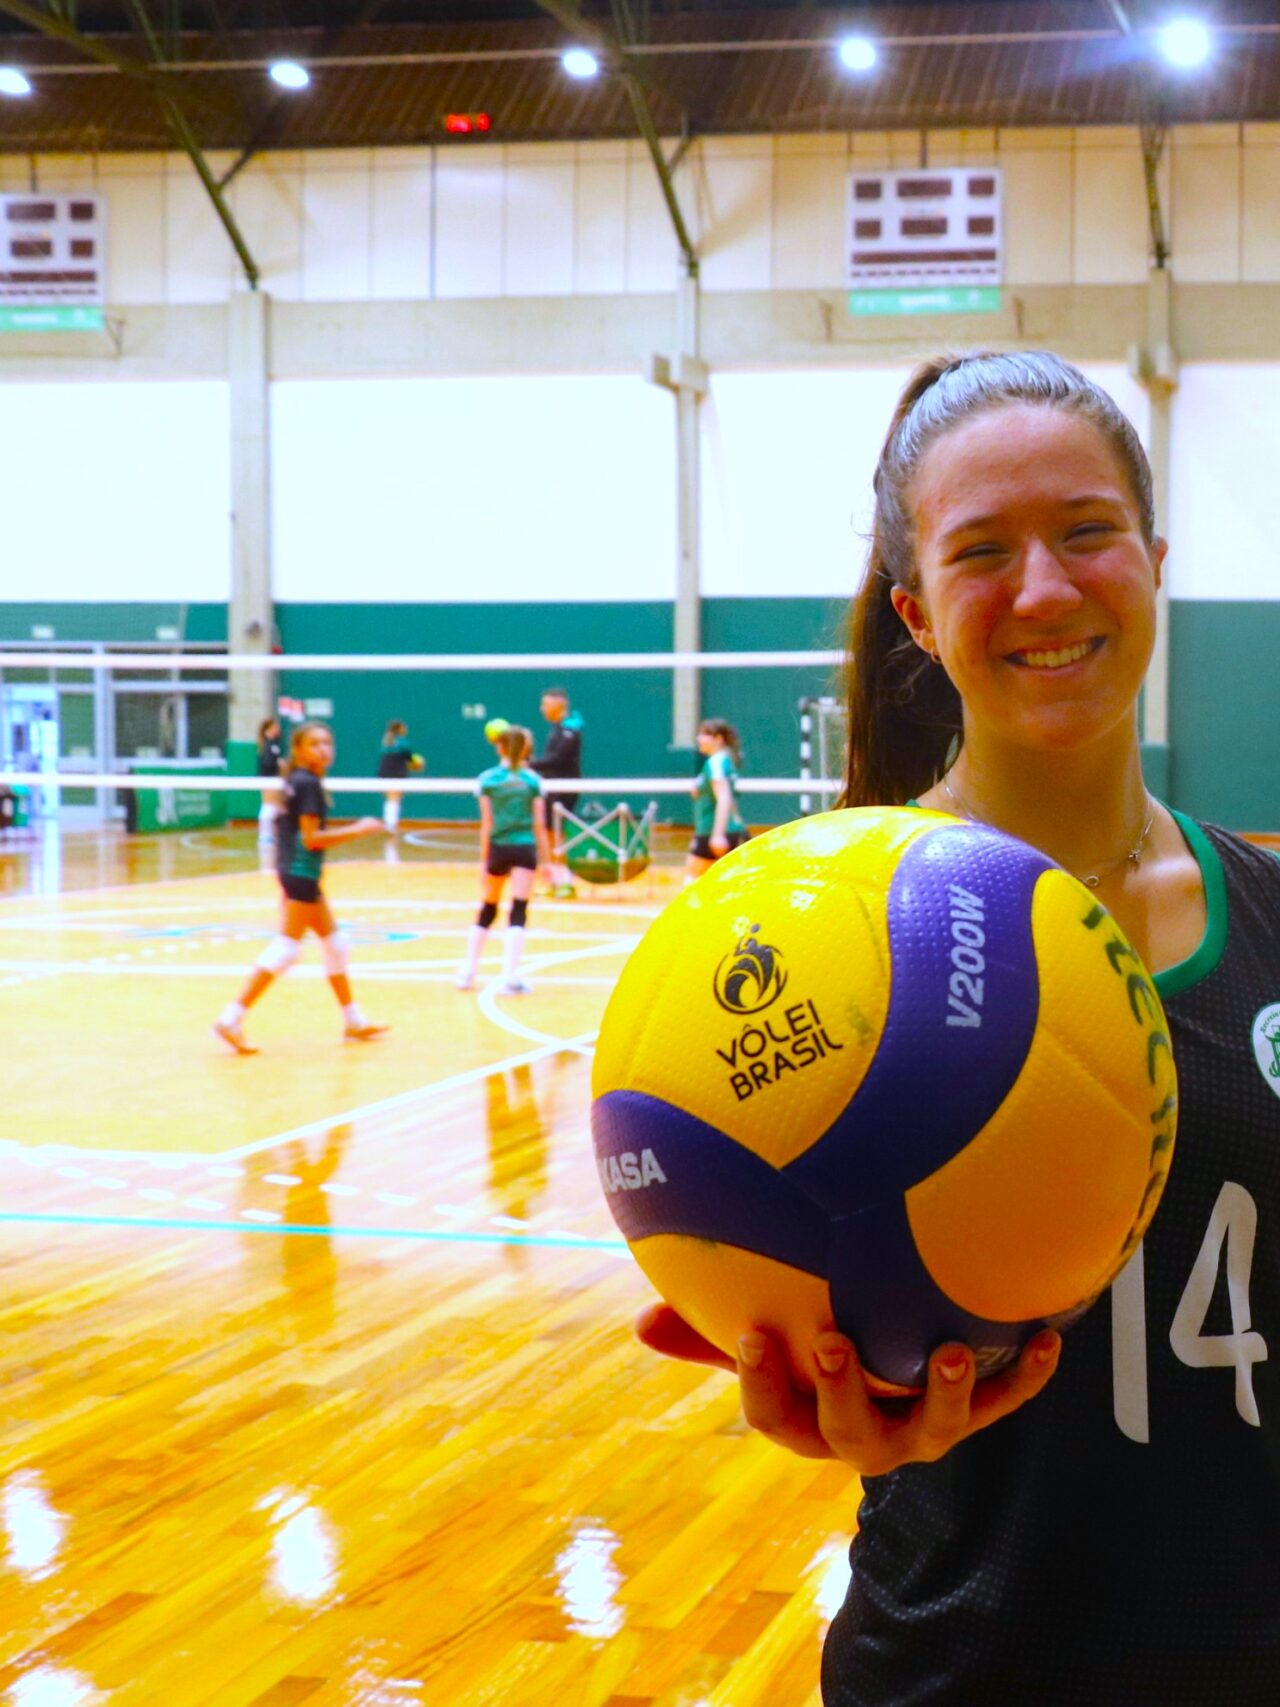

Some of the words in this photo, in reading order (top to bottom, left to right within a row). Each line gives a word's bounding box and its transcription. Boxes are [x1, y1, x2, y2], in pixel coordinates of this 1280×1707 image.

[946, 883, 985, 1028] V200W
[716, 998, 821, 1068] VÔLEI
[730, 1028, 843, 1101] BRASIL
[1112, 1181, 1268, 1443] 14
